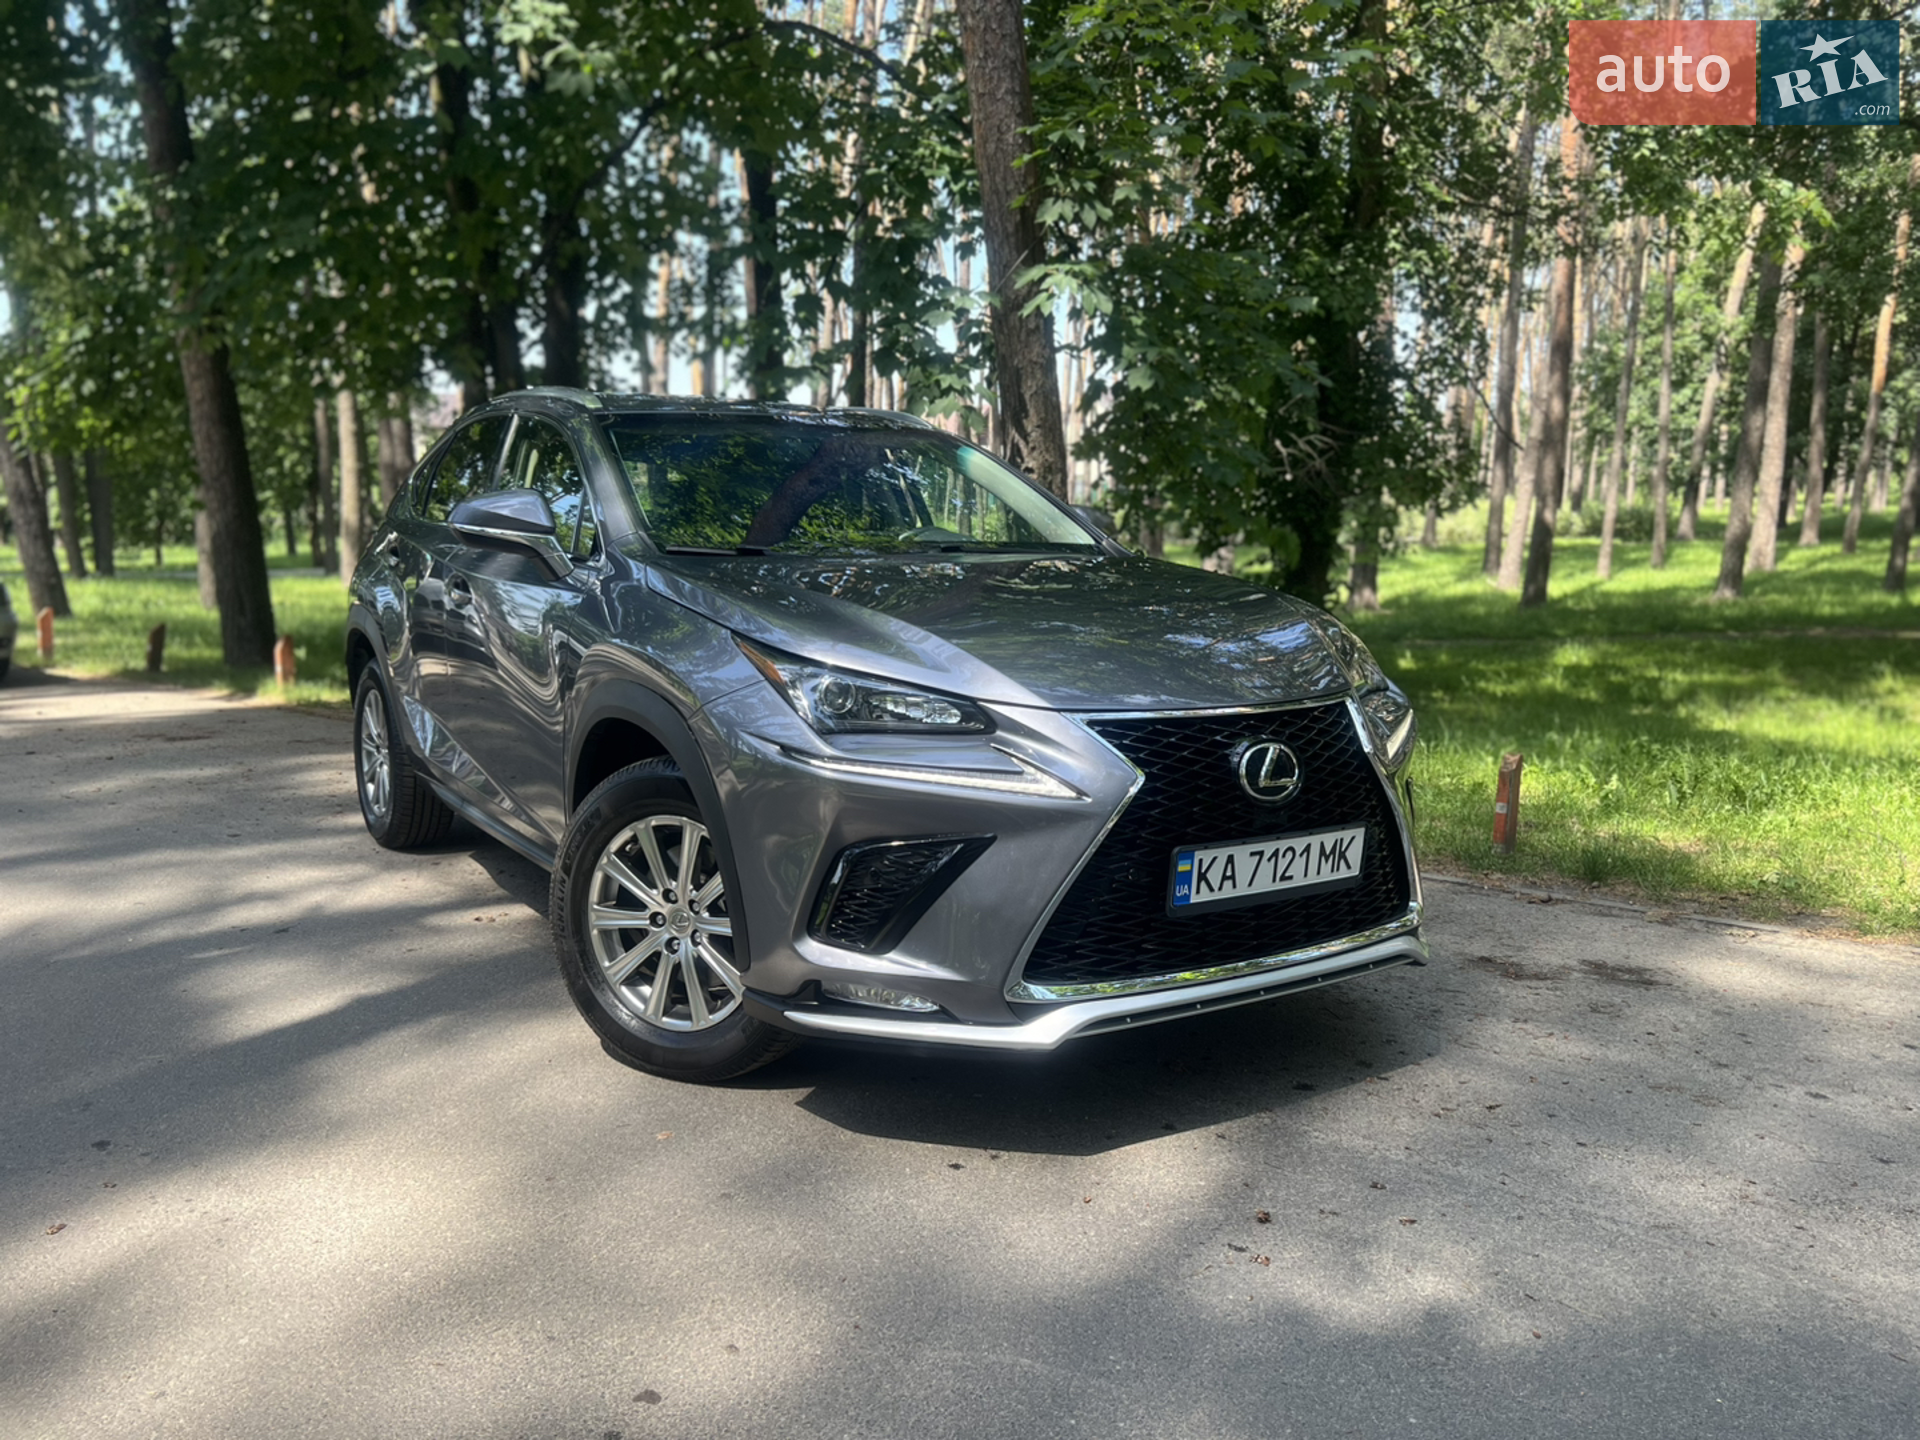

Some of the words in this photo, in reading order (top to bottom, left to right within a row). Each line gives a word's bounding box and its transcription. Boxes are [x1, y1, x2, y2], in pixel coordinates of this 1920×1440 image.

[1195, 853, 1237, 895] KA
[1247, 842, 1312, 888] 7121
[1316, 835, 1356, 876] MK
[1175, 884, 1190, 897] UA
